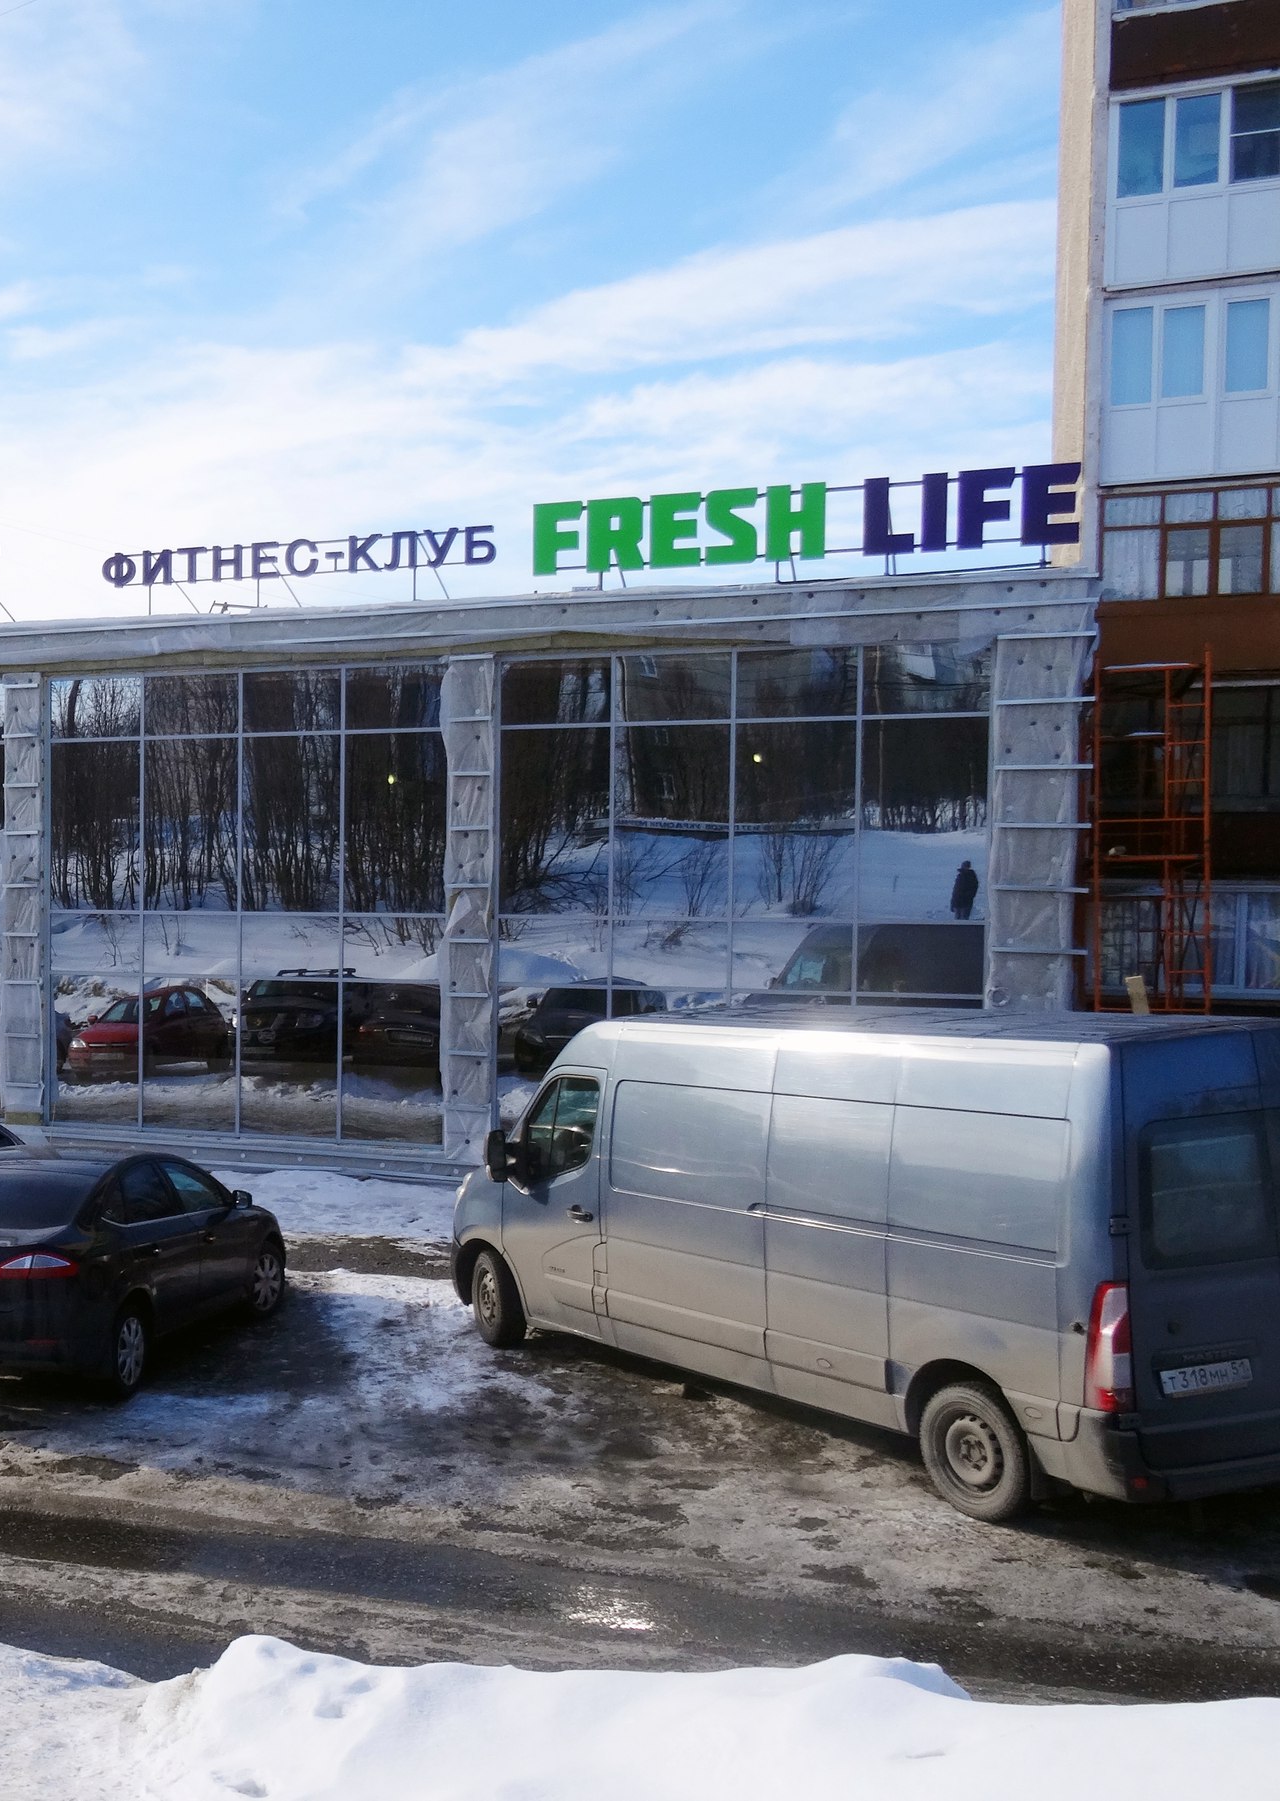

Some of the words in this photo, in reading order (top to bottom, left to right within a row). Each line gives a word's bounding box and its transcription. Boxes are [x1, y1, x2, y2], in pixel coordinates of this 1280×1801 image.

[101, 524, 497, 588] ФИТНЕС-КЛУБ
[533, 481, 826, 577] FRESH
[863, 462, 1081, 556] LIFE
